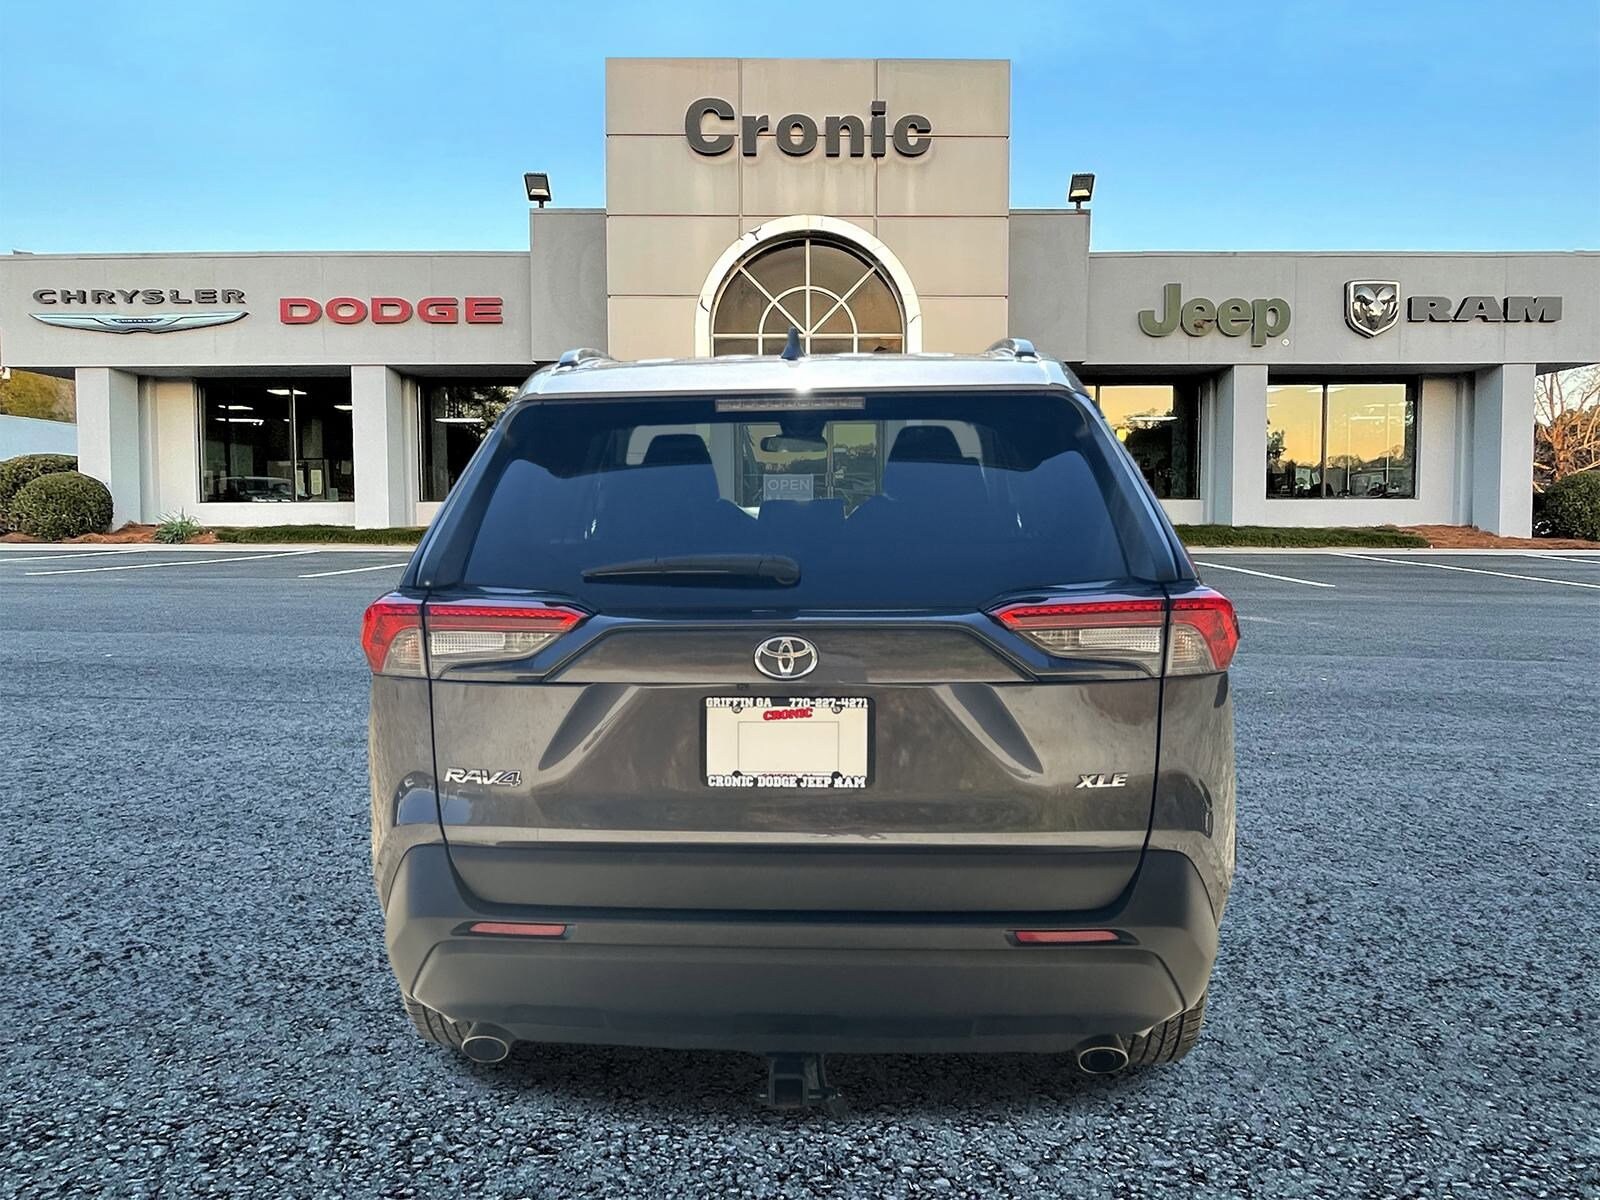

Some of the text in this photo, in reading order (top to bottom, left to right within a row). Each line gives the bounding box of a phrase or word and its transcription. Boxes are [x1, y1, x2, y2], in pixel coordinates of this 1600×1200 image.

[685, 97, 932, 157] Cronic
[32, 288, 248, 305] CHRYSLER
[279, 297, 504, 325] DODGE
[1138, 283, 1291, 347] Jeep
[1407, 296, 1562, 322] RAM
[767, 479, 810, 490] OPEN
[705, 697, 869, 708] GRIFFIN GA 770-227-4271
[763, 707, 813, 721] CRONIC
[444, 766, 522, 787] RAV4
[707, 775, 754, 788] CRONIC
[757, 776, 798, 788] DODGE
[799, 777, 832, 788] JEEP
[1075, 773, 1129, 789] XLE
